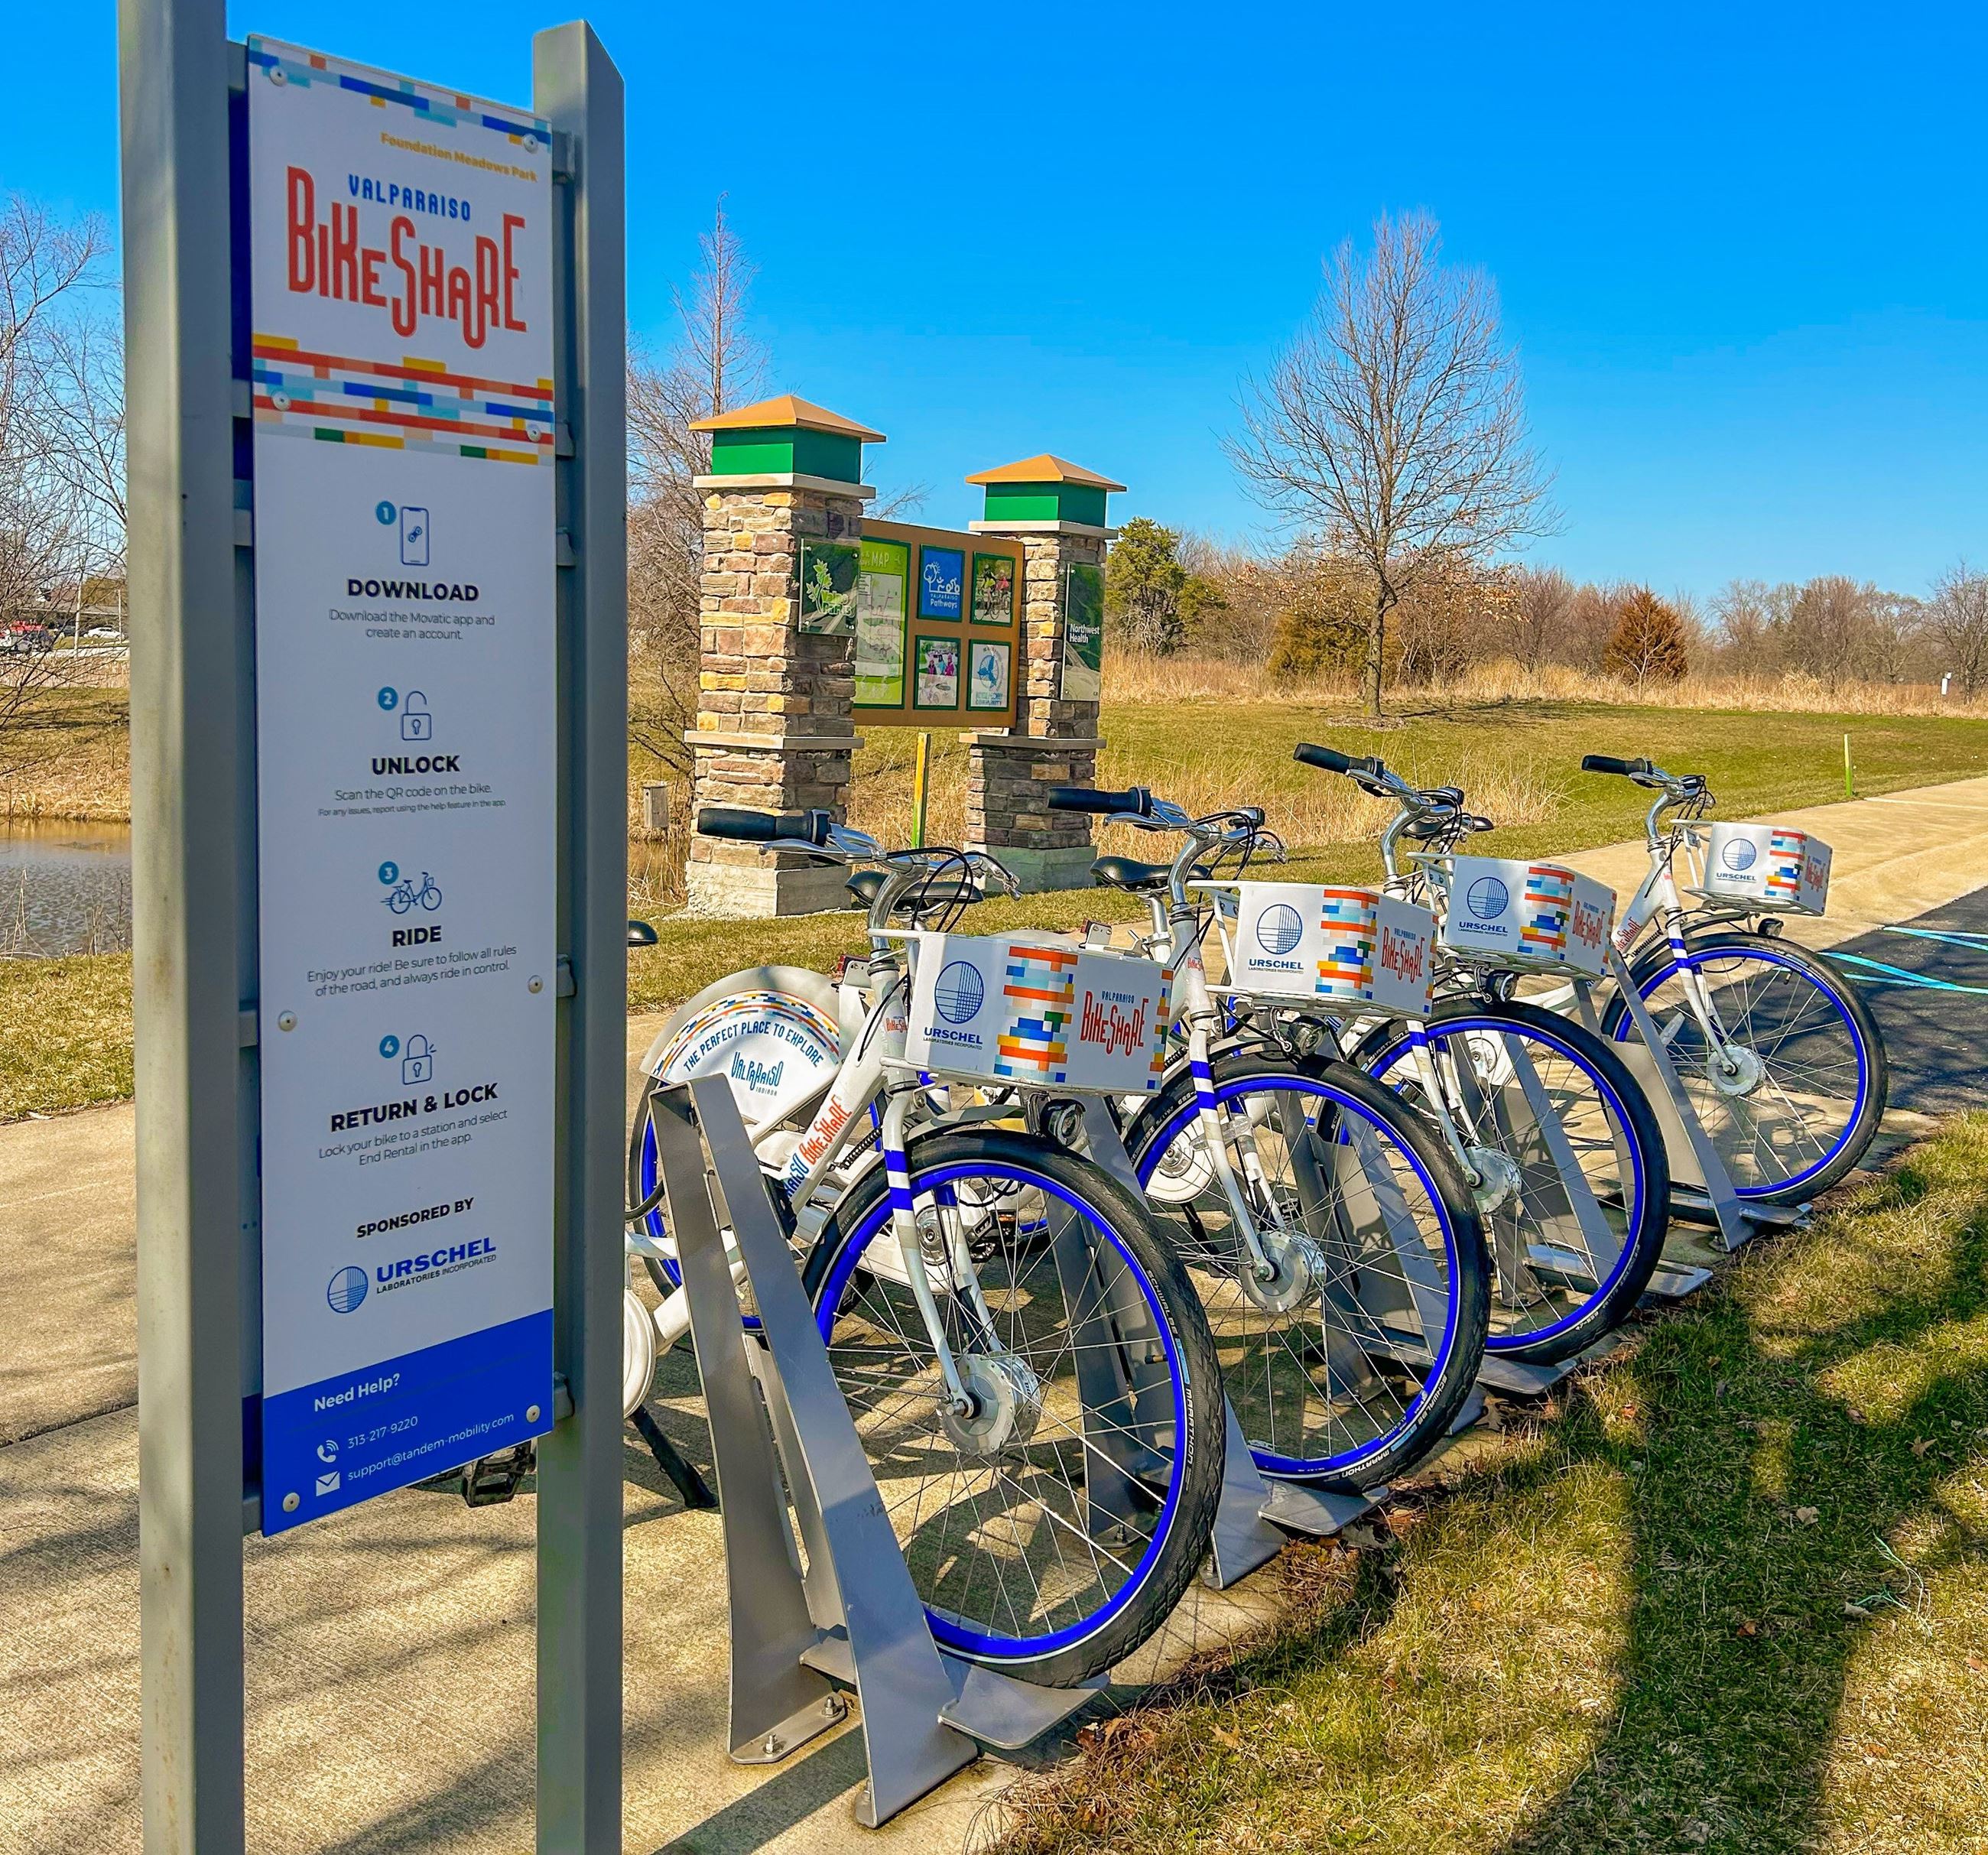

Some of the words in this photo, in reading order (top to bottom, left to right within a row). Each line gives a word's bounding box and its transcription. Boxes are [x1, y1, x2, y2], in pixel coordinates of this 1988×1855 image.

[381, 132, 452, 160] Foundation
[455, 151, 510, 176] Meadows
[512, 165, 538, 183] Park
[348, 174, 471, 222] VALPARAISO
[872, 551, 889, 567] MAP
[347, 579, 479, 602] DOWNLOAD
[930, 599, 957, 609] Pathways
[330, 609, 388, 622] Download
[389, 611, 409, 623] the
[410, 612, 452, 625] Movatic
[453, 616, 474, 628] app
[475, 615, 495, 625] and
[365, 628, 401, 638] create
[402, 630, 417, 638] an
[1070, 623, 1100, 635] Northwest
[1069, 632, 1089, 643] Health
[372, 755, 460, 775] UNLOCK
[335, 788, 363, 801] Scan
[364, 788, 385, 800] the
[386, 787, 404, 800] QR
[405, 785, 432, 798] code
[434, 786, 449, 796] on
[450, 783, 467, 795] the
[318, 807, 331, 817] For
[332, 807, 348, 817] any
[372, 804, 395, 816] report
[397, 804, 417, 815] using
[417, 803, 430, 812] the
[430, 801, 447, 811] help
[447, 800, 472, 809] feature
[479, 799, 492, 807] the
[1716, 872, 1756, 882] URSCHEL
[392, 925, 442, 947] RIDE
[1459, 921, 1509, 934] URSCHEL
[307, 969, 339, 984] Enjoy
[340, 965, 365, 979] your
[369, 961, 393, 974] ride!
[395, 958, 410, 970] Be
[411, 957, 435, 969] sure
[436, 955, 447, 966] to
[448, 950, 479, 963] follow
[479, 947, 492, 960] all
[493, 945, 517, 957] rules
[1249, 958, 1304, 970] URSCHEL
[315, 984, 329, 997] of
[329, 982, 349, 995] the
[350, 978, 378, 992] road,
[379, 976, 401, 988] and
[403, 970, 438, 986] always
[440, 966, 460, 979] ride
[462, 966, 473, 976] in
[1101, 990, 1135, 1005] VALPARAISO
[683, 1051, 701, 1073] THE
[699, 1024, 739, 1057] PERFECT
[740, 1021, 771, 1035] PLACE
[774, 1023, 787, 1038] TO
[785, 1028, 824, 1069] EXPLORE
[924, 1026, 983, 1044] URSCHEL
[330, 1098, 418, 1132] RETURN
[424, 1095, 438, 1113] &
[443, 1082, 499, 1109] LOCK
[319, 1144, 346, 1159] Lock
[346, 1139, 372, 1155] your
[374, 1132, 398, 1147] bike
[399, 1131, 411, 1142] to
[412, 1129, 419, 1139] a
[420, 1120, 456, 1137] station
[457, 1116, 478, 1129] and
[479, 1109, 508, 1123] select
[359, 1150, 381, 1166] End
[383, 1142, 418, 1161] Rental
[420, 1141, 430, 1152] in
[431, 1136, 450, 1149] the
[450, 1132, 473, 1148] app.
[356, 1204, 450, 1238] SPONSORED
[454, 1197, 474, 1213] BY
[376, 1236, 497, 1283] URSCHEL
[376, 1269, 441, 1294] LABORATORIES
[440, 1253, 497, 1276] INCORPORATED
[1147, 1269, 1178, 1335] SCHWALBE
[313, 1386, 355, 1412] Need
[357, 1373, 401, 1399] Help?
[1417, 1374, 1448, 1425] SCHWALBE
[347, 1415, 419, 1450] 313-217-9220
[1185, 1388, 1194, 1465] MARATHON
[347, 1412, 515, 1481] support@tandem-mobility.com
[1341, 1449, 1390, 1478] MARATHON
